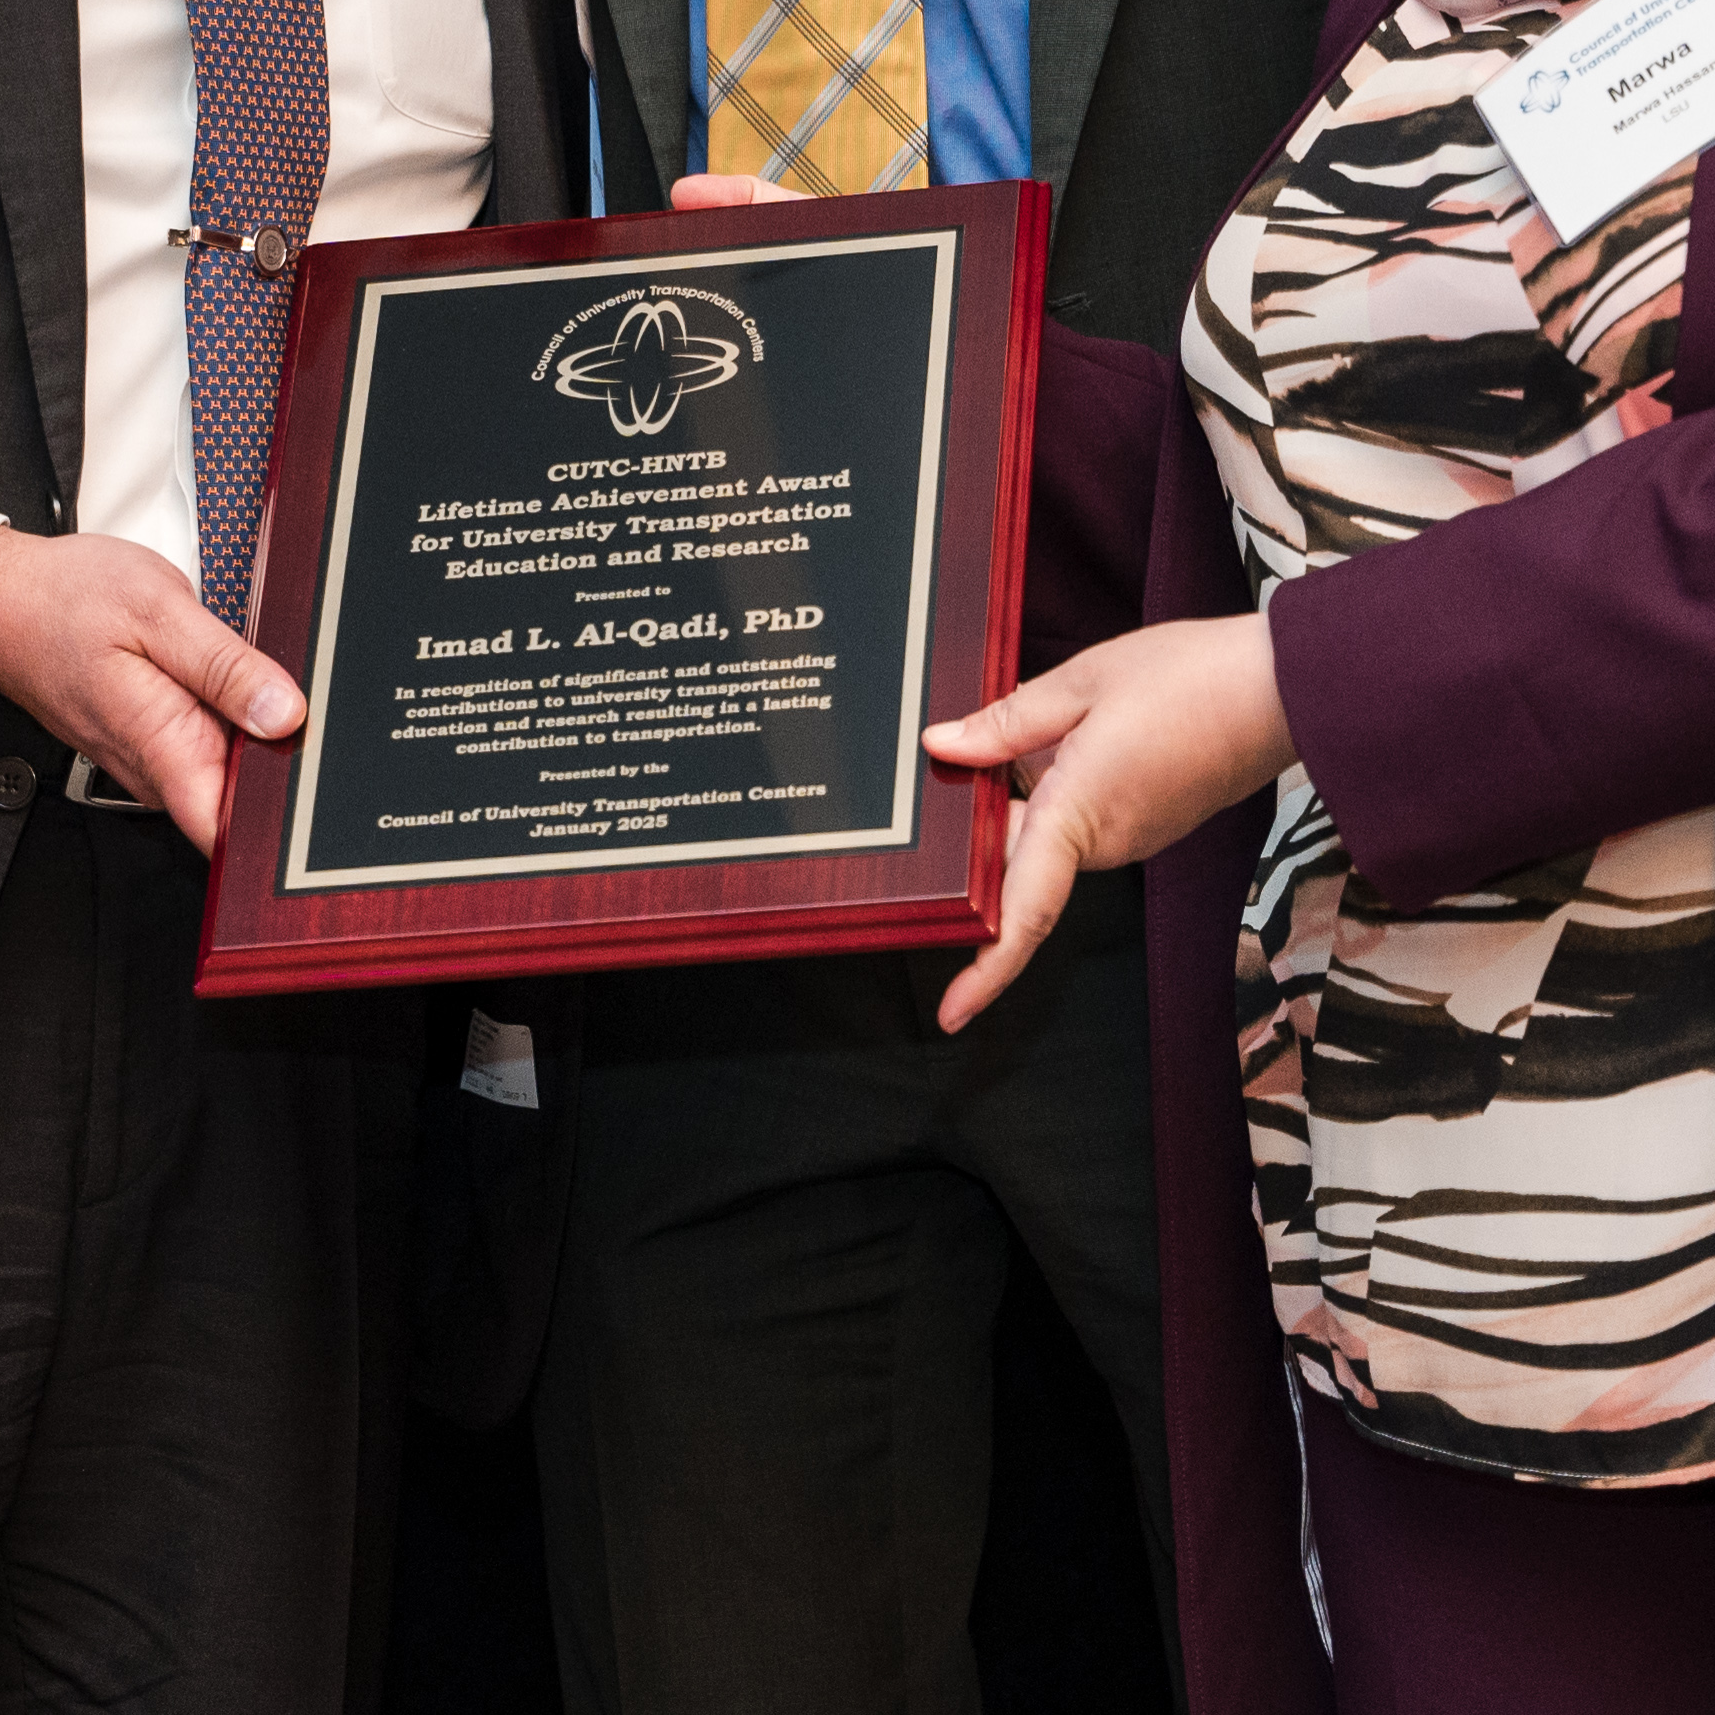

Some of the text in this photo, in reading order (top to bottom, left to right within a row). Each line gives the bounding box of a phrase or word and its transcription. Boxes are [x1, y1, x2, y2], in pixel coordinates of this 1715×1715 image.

[1568, 22, 1622, 64] Council
[1624, 11, 1638, 26] of
[1575, 9, 1673, 77] Transportation
[1607, 43, 1692, 103] Marwa
[1612, 99, 1661, 134] Marwa
[1661, 99, 1690, 124] LSU
[531, 285, 764, 381] Council of University Transportation Centers
[547, 450, 727, 482] CUTC-HNTB
[417, 468, 851, 523] Lifetime Achievement Award
[409, 501, 852, 553] for University Transportation
[444, 532, 810, 580] Education and Research
[574, 586, 672, 603] Presented to
[415, 605, 824, 660] Imad L. Al-Qadi, PhD
[394, 654, 837, 700] In recognition of significant and outstanding
[405, 675, 821, 719] contributions to university transportation
[391, 694, 832, 740] education and research resulting in a lasting
[455, 720, 762, 755] contribution to transportation.
[539, 762, 670, 782] Presented by the
[377, 784, 827, 829] Council of University Transportation Centers
[529, 813, 669, 839] January 2025
